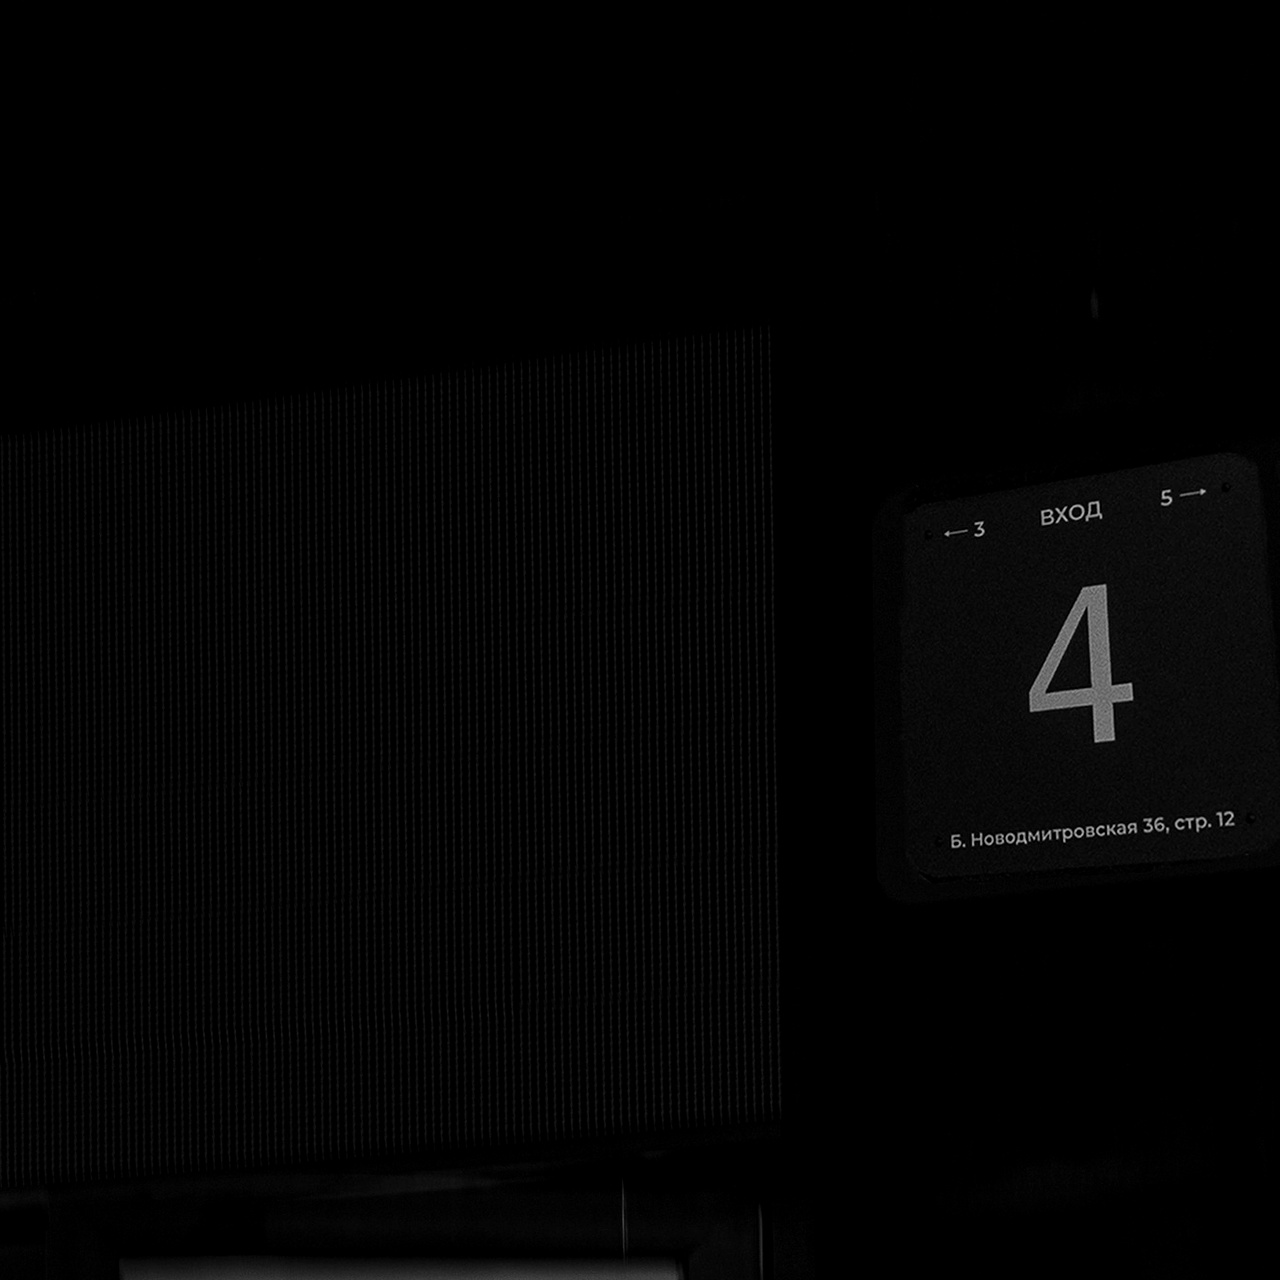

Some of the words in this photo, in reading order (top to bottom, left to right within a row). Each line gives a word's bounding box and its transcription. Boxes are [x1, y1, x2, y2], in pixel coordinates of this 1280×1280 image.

[1160, 488, 1174, 508] 5
[1039, 500, 1104, 527] ВХОД
[974, 520, 987, 539] 3
[1028, 583, 1135, 744] 4
[949, 834, 968, 850] Б.
[970, 822, 1139, 848] Новодмитровская
[1142, 815, 1171, 834] 36,
[1173, 816, 1213, 834] стр.
[1215, 809, 1236, 828] 12
